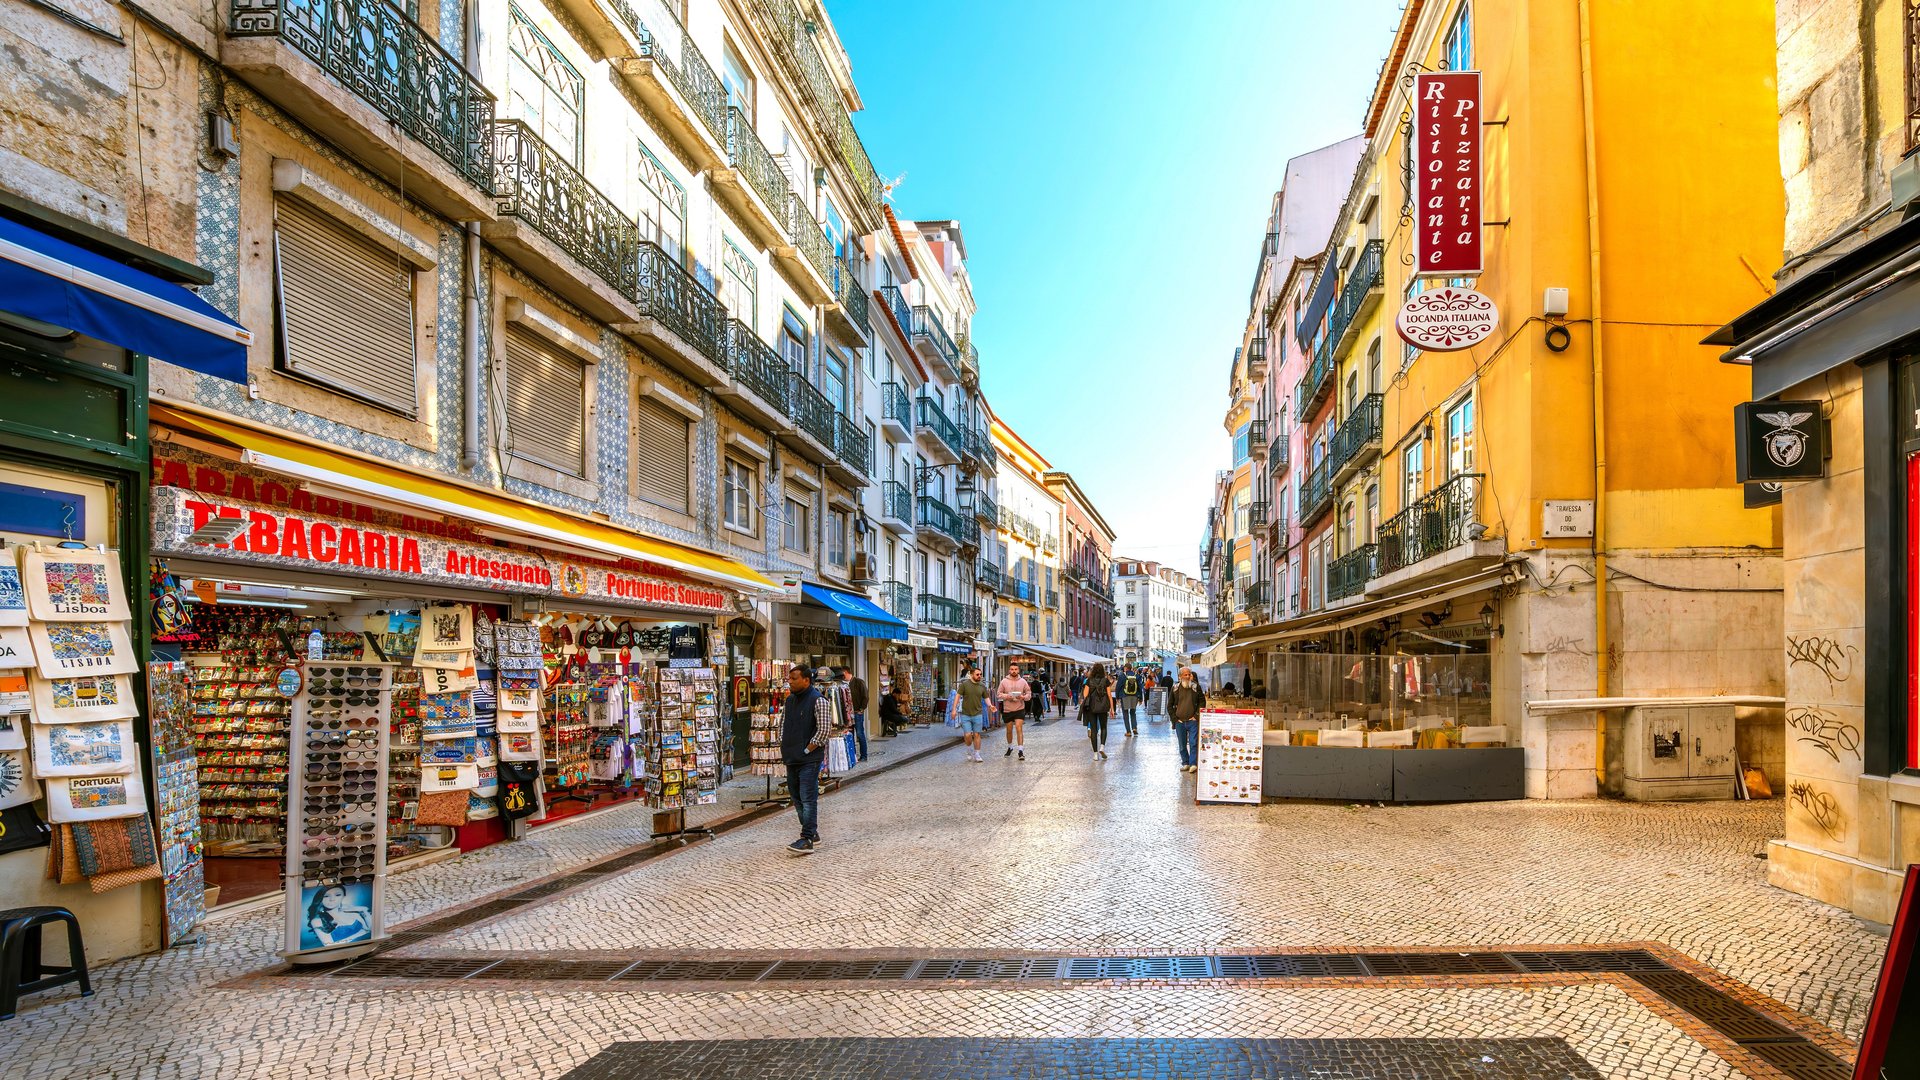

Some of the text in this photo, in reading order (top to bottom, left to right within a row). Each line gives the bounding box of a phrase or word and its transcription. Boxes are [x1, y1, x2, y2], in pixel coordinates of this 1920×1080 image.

[1424, 82, 1445, 263] Ristorante
[1453, 100, 1474, 245] Pizzaria
[1406, 313, 1490, 323] LOCANDA ITALIANA
[185, 500, 422, 574] TABACARIA
[446, 550, 551, 587] Artesanato
[607, 573, 675, 601] Português
[678, 587, 724, 609] Souvenir
[55, 604, 107, 614] Lisboa
[61, 657, 111, 668] LISBOA
[76, 700, 99, 708] LISBOA
[73, 777, 120, 788] PORTUGAL
